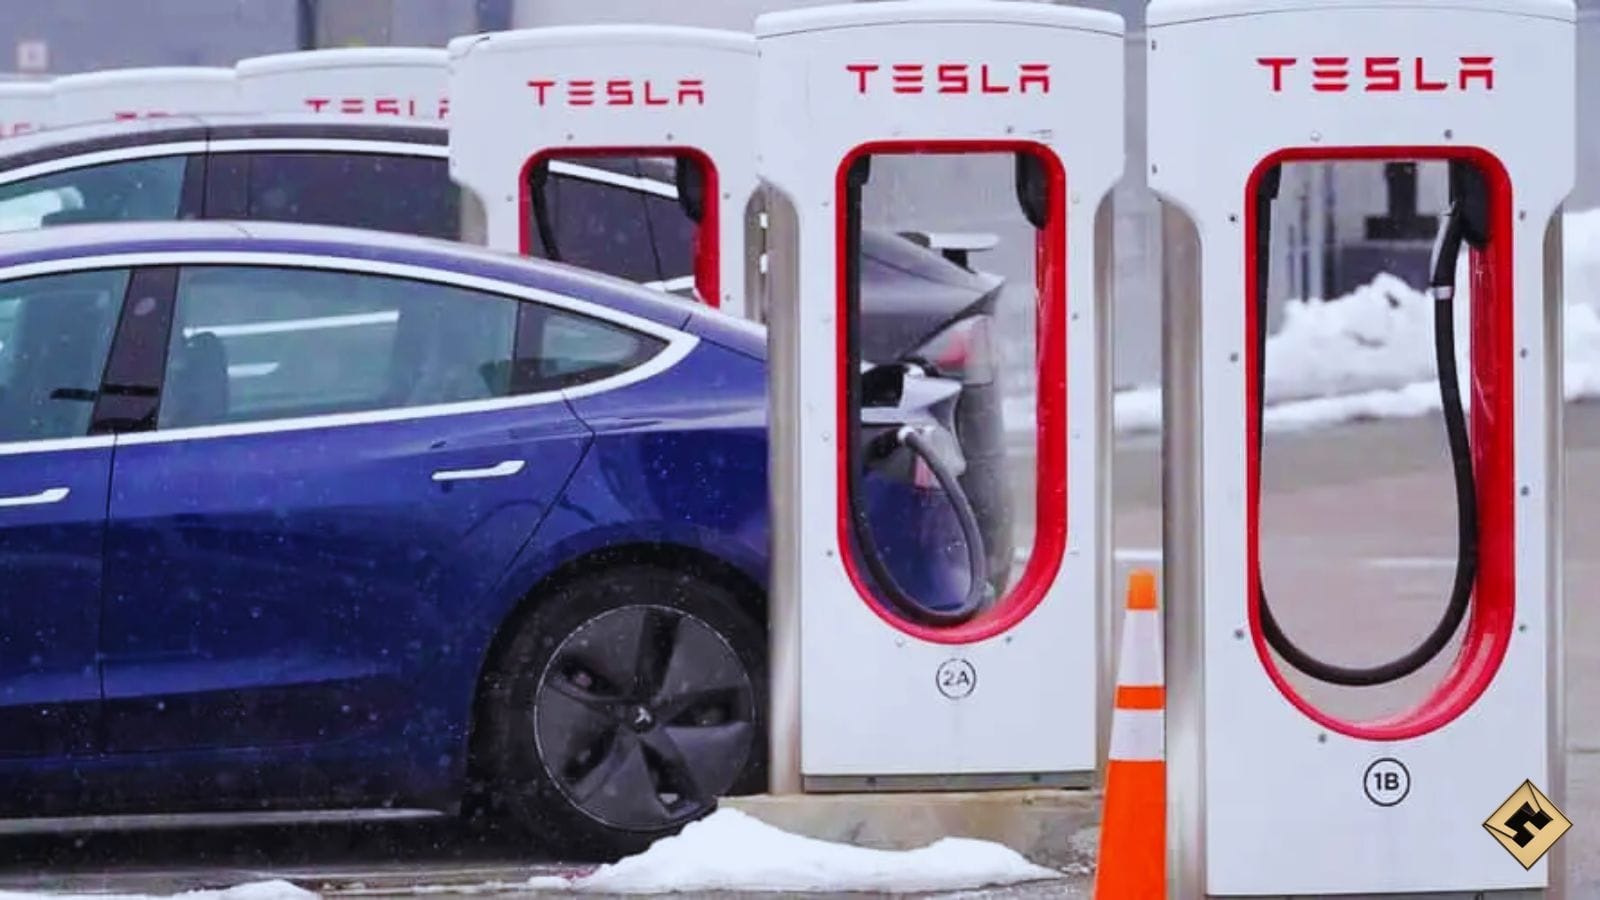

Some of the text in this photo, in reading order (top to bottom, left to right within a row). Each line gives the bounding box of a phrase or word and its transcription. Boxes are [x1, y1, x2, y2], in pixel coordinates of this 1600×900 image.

[846, 64, 1051, 95] TESLA
[1256, 56, 1495, 92] TESLA
[527, 79, 705, 106] TESLA
[943, 670, 970, 687] 2A
[1374, 772, 1399, 790] 1B
